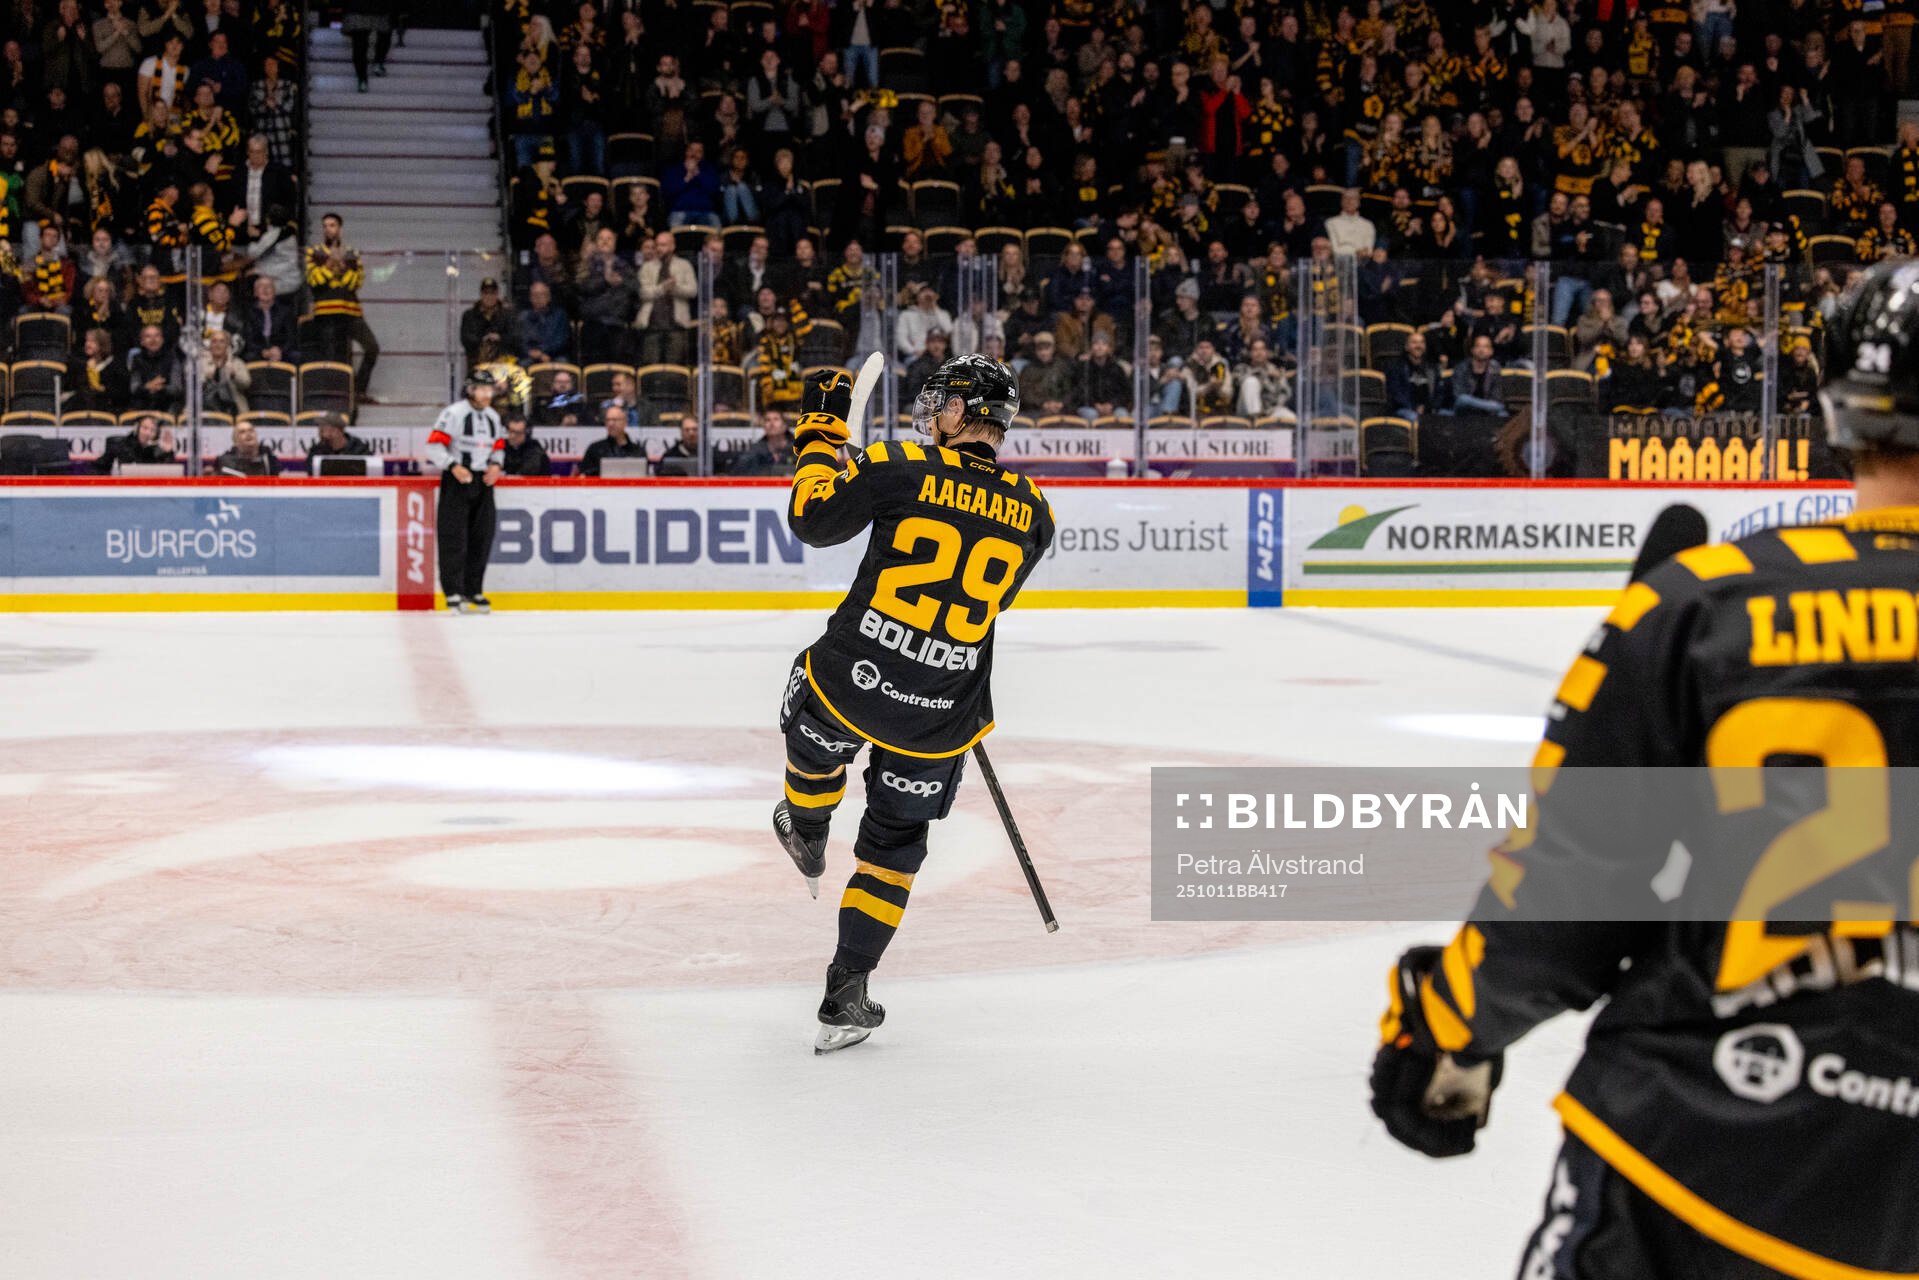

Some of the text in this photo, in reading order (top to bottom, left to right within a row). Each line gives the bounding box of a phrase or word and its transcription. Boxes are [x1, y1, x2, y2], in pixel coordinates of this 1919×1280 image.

[969, 461, 997, 475] CCM
[1146, 439, 1202, 456] OCAL
[917, 474, 1033, 533] AAGAARD
[106, 529, 258, 564] BJURFORS
[407, 491, 425, 585] CCM
[489, 509, 803, 565] BOLIDEN
[1128, 520, 1229, 552] Jurist
[1256, 491, 1275, 582] CCM
[1387, 523, 1636, 551] NORRMASKINER
[869, 516, 1025, 643] 29
[859, 608, 982, 671] BOLIDEN
[1746, 588, 1919, 667] LIND
[880, 681, 955, 710] Contractor
[800, 724, 858, 753] coop
[881, 771, 943, 798] coop
[1706, 696, 1919, 991] 2
